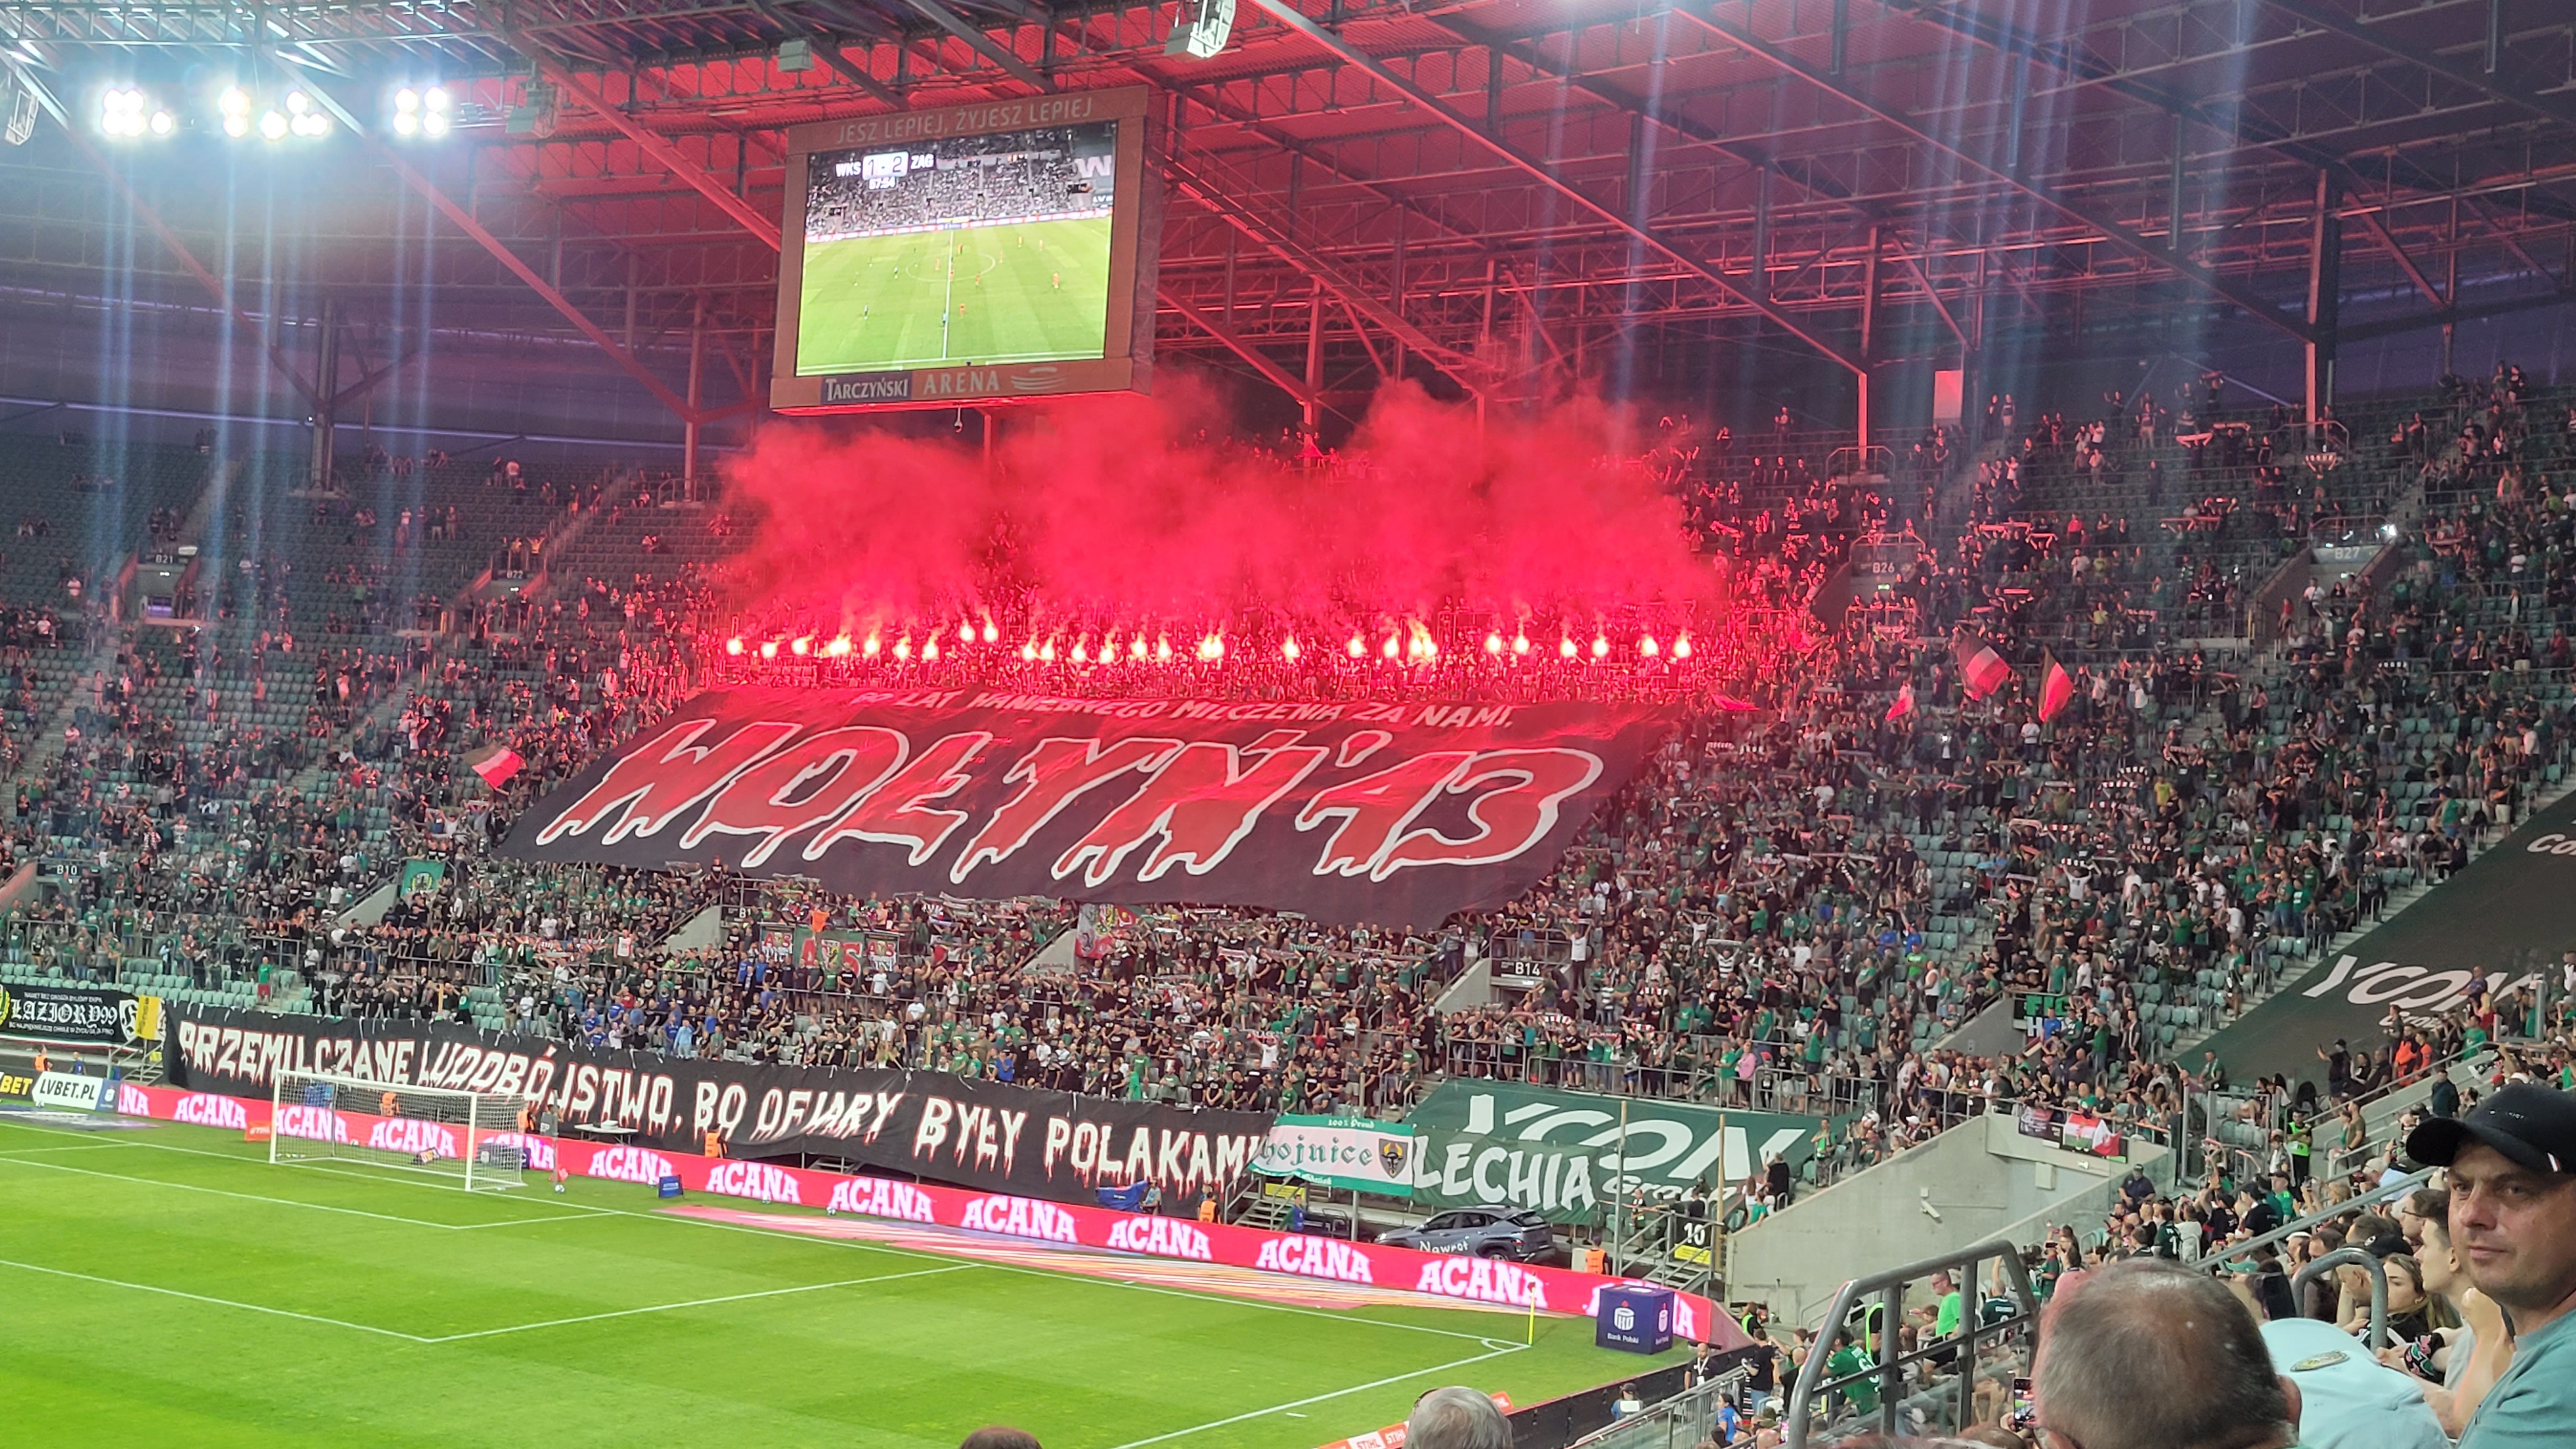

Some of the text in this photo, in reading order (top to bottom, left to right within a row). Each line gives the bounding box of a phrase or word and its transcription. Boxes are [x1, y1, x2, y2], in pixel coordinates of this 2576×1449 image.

[838, 98, 1092, 145] JESZ LEPIEJ, ŻYJESZ LEPIEJ
[836, 162, 861, 177] WKS
[910, 153, 935, 169] ZAG
[825, 371, 999, 401] TARCZYŃSKI ARENA
[2335, 547, 2360, 559] B27
[895, 689, 964, 709] LAT
[1169, 701, 1342, 721] MILCZENIA
[1351, 703, 1407, 723] ZA
[2527, 834, 2576, 855] Co
[57, 864, 77, 875] B10
[1515, 962, 1540, 976] B14
[1, 1075, 33, 1096] BET
[40, 1078, 95, 1100] LVBET.PL
[693, 1082, 747, 1142] BO
[912, 1096, 1028, 1179] BYŁY
[1413, 1135, 1596, 1211] LECHIA
[174, 1094, 247, 1130] ACANA
[275, 1106, 348, 1143] ACANA
[369, 1117, 455, 1158] ACANA
[588, 1147, 673, 1184] ACANA
[706, 1161, 801, 1204] ACANA
[831, 1177, 935, 1223] ACANA
[960, 1194, 1078, 1243] ACANA
[1107, 1215, 1212, 1261] ACANA
[1256, 1236, 1373, 1284] ACANA
[1416, 1258, 1548, 1308] ACANA
[1683, 1222, 1705, 1245] 10
[1357, 1438, 1381, 1449] STIHL
[1385, 1429, 1406, 1445] STIH
